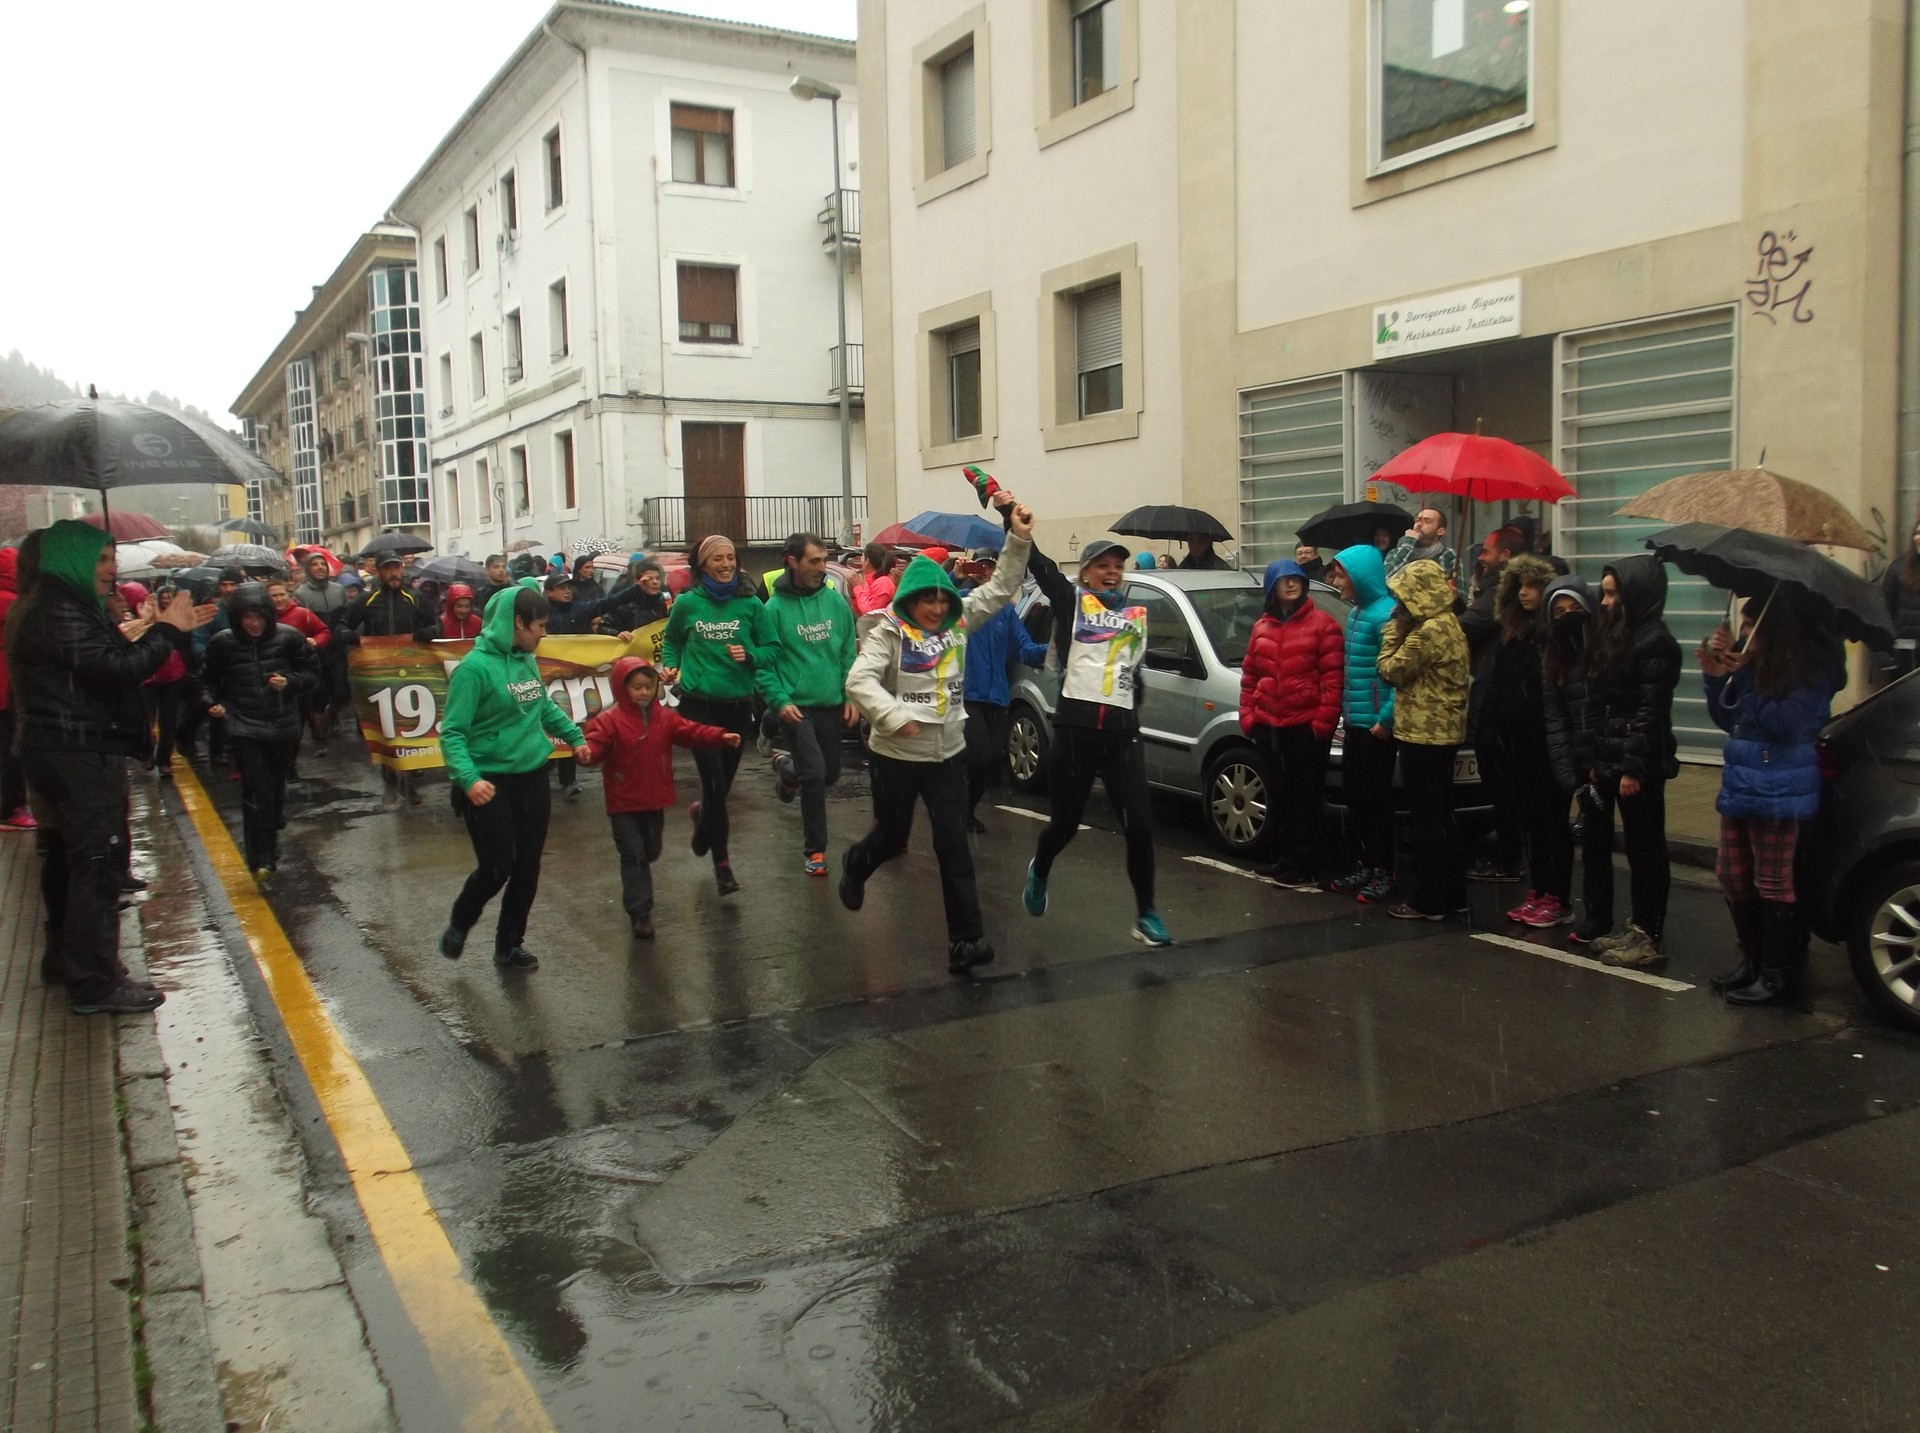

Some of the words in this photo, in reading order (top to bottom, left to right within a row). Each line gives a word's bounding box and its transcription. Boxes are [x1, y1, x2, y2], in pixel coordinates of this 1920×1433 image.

[1405, 303, 1467, 323] Derrigorrezko
[1471, 294, 1515, 311] Bigarren
[1405, 322, 1462, 341] Hezkuntzako
[1465, 315, 1514, 331] Institutua
[703, 630, 735, 640] ikasi
[517, 688, 542, 703] ikasi
[902, 692, 931, 704] 0965
[395, 744, 442, 758] Urepel
